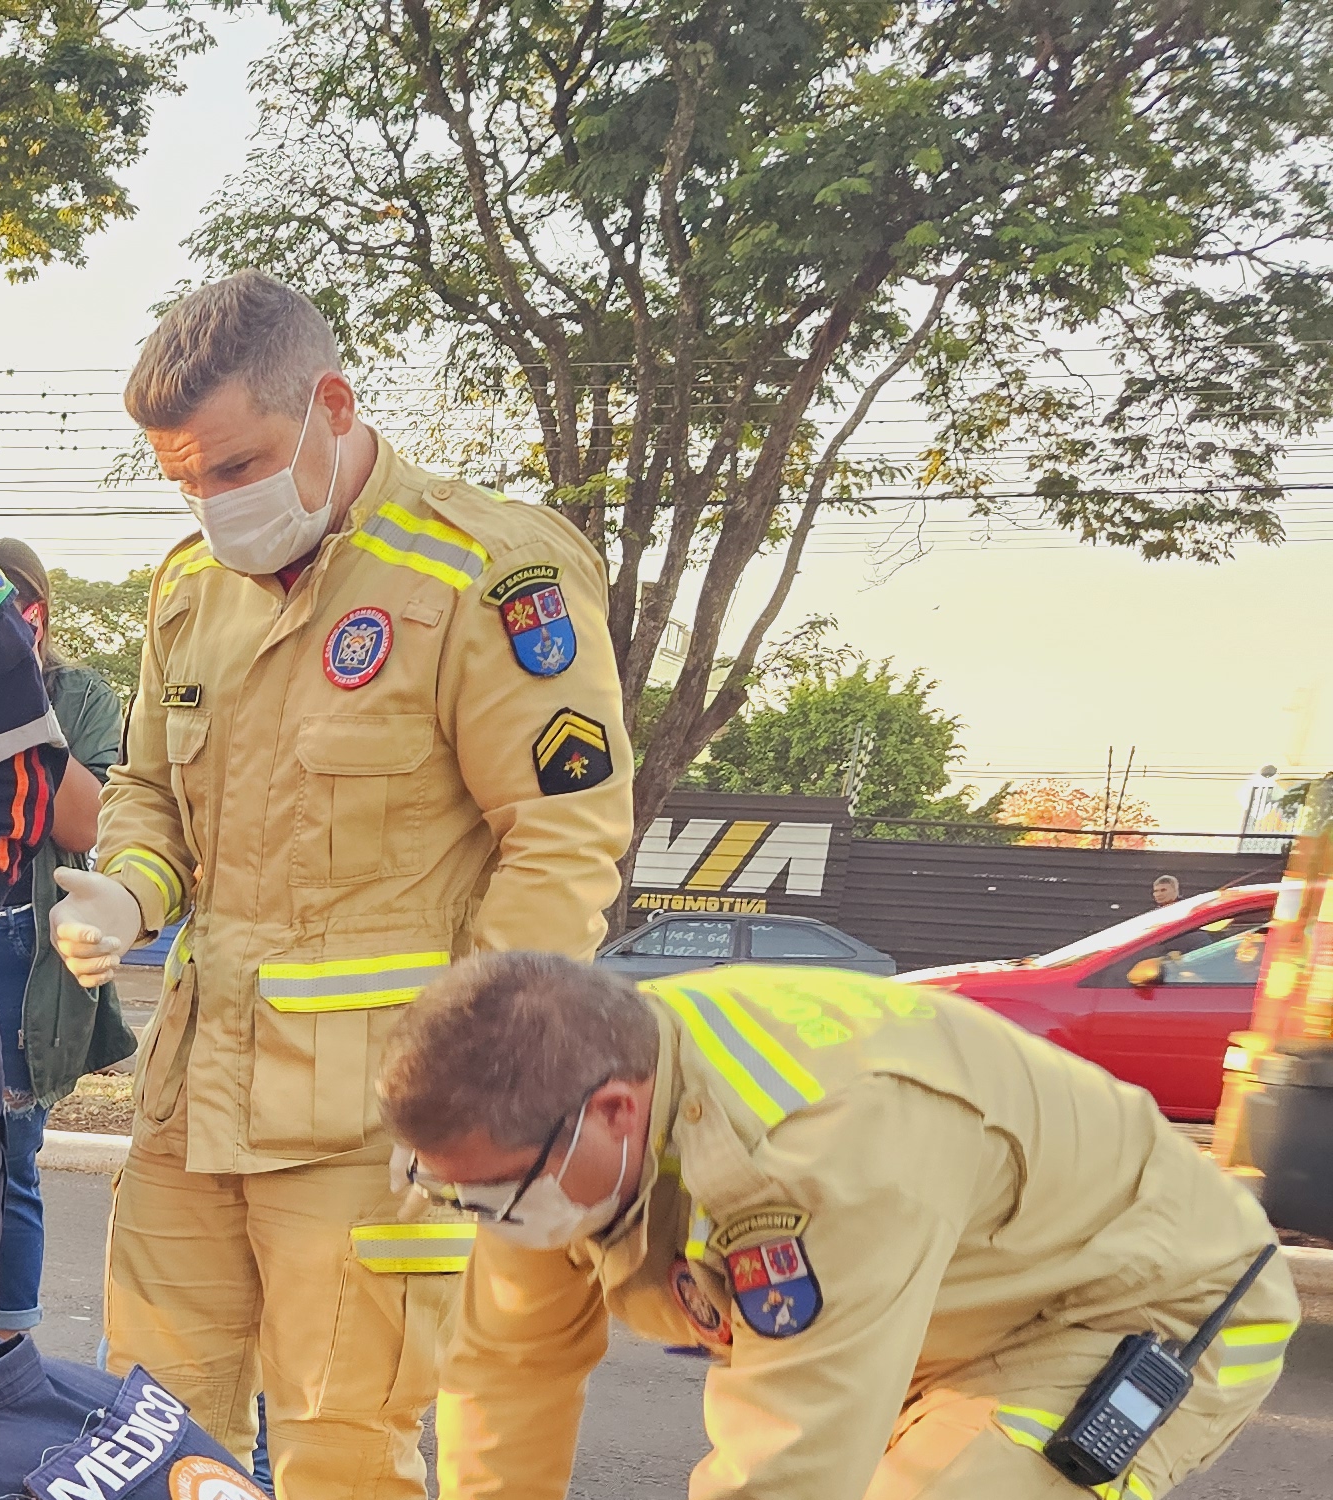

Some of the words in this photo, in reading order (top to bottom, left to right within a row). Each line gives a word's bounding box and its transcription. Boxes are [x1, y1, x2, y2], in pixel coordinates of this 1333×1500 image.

[505, 566, 554, 589] BATALHÃO
[630, 817, 833, 897] VIA
[632, 893, 767, 914] AUTOMOTIVA
